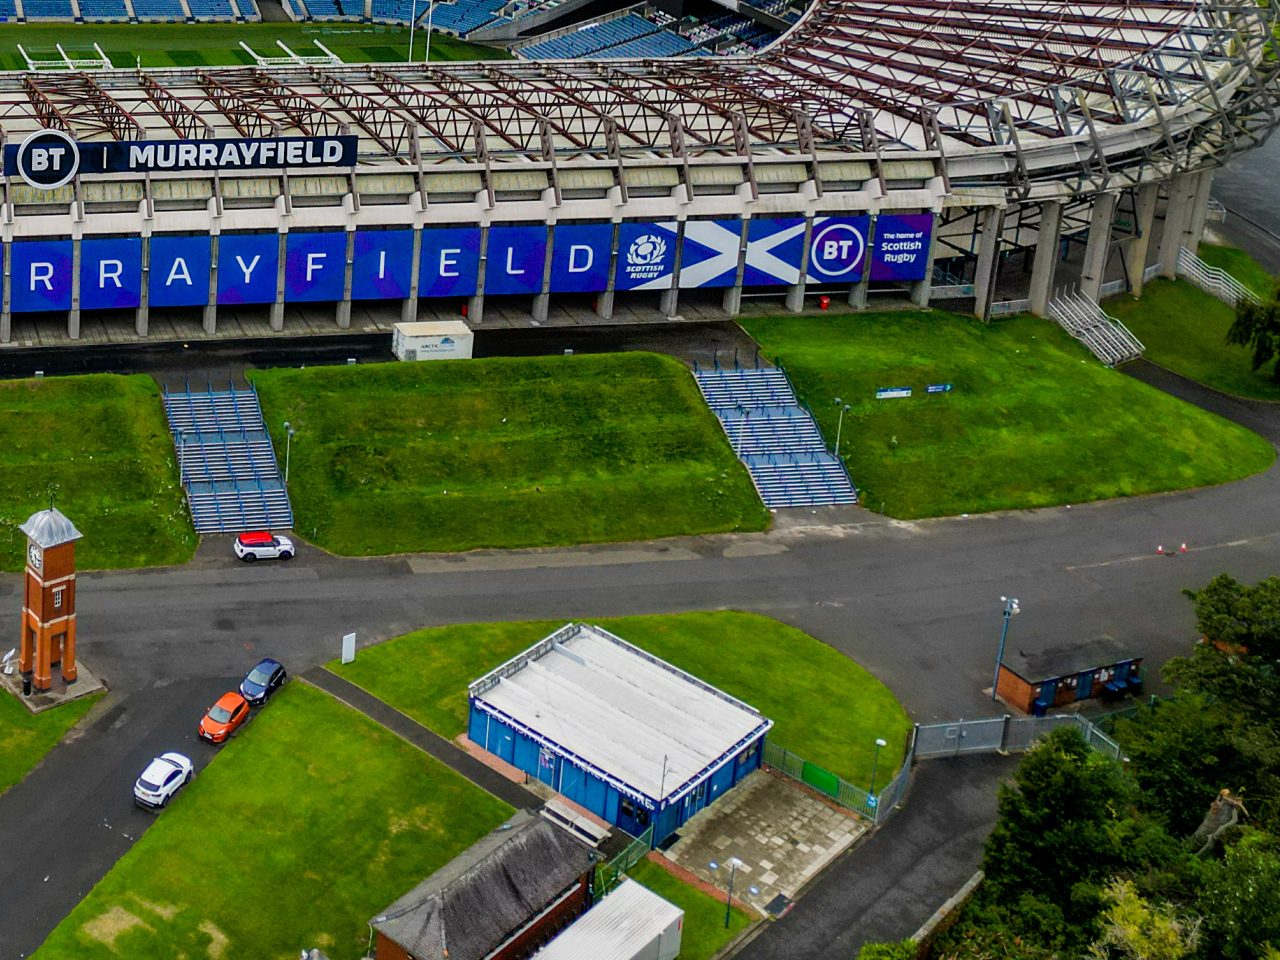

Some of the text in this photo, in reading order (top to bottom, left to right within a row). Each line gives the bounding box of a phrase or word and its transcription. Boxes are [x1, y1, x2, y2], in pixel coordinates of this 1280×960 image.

[31, 140, 343, 172] BT MURRAYFIELD
[823, 240, 852, 259] BT
[881, 241, 922, 251] Scottish
[884, 253, 916, 264] Rugby
